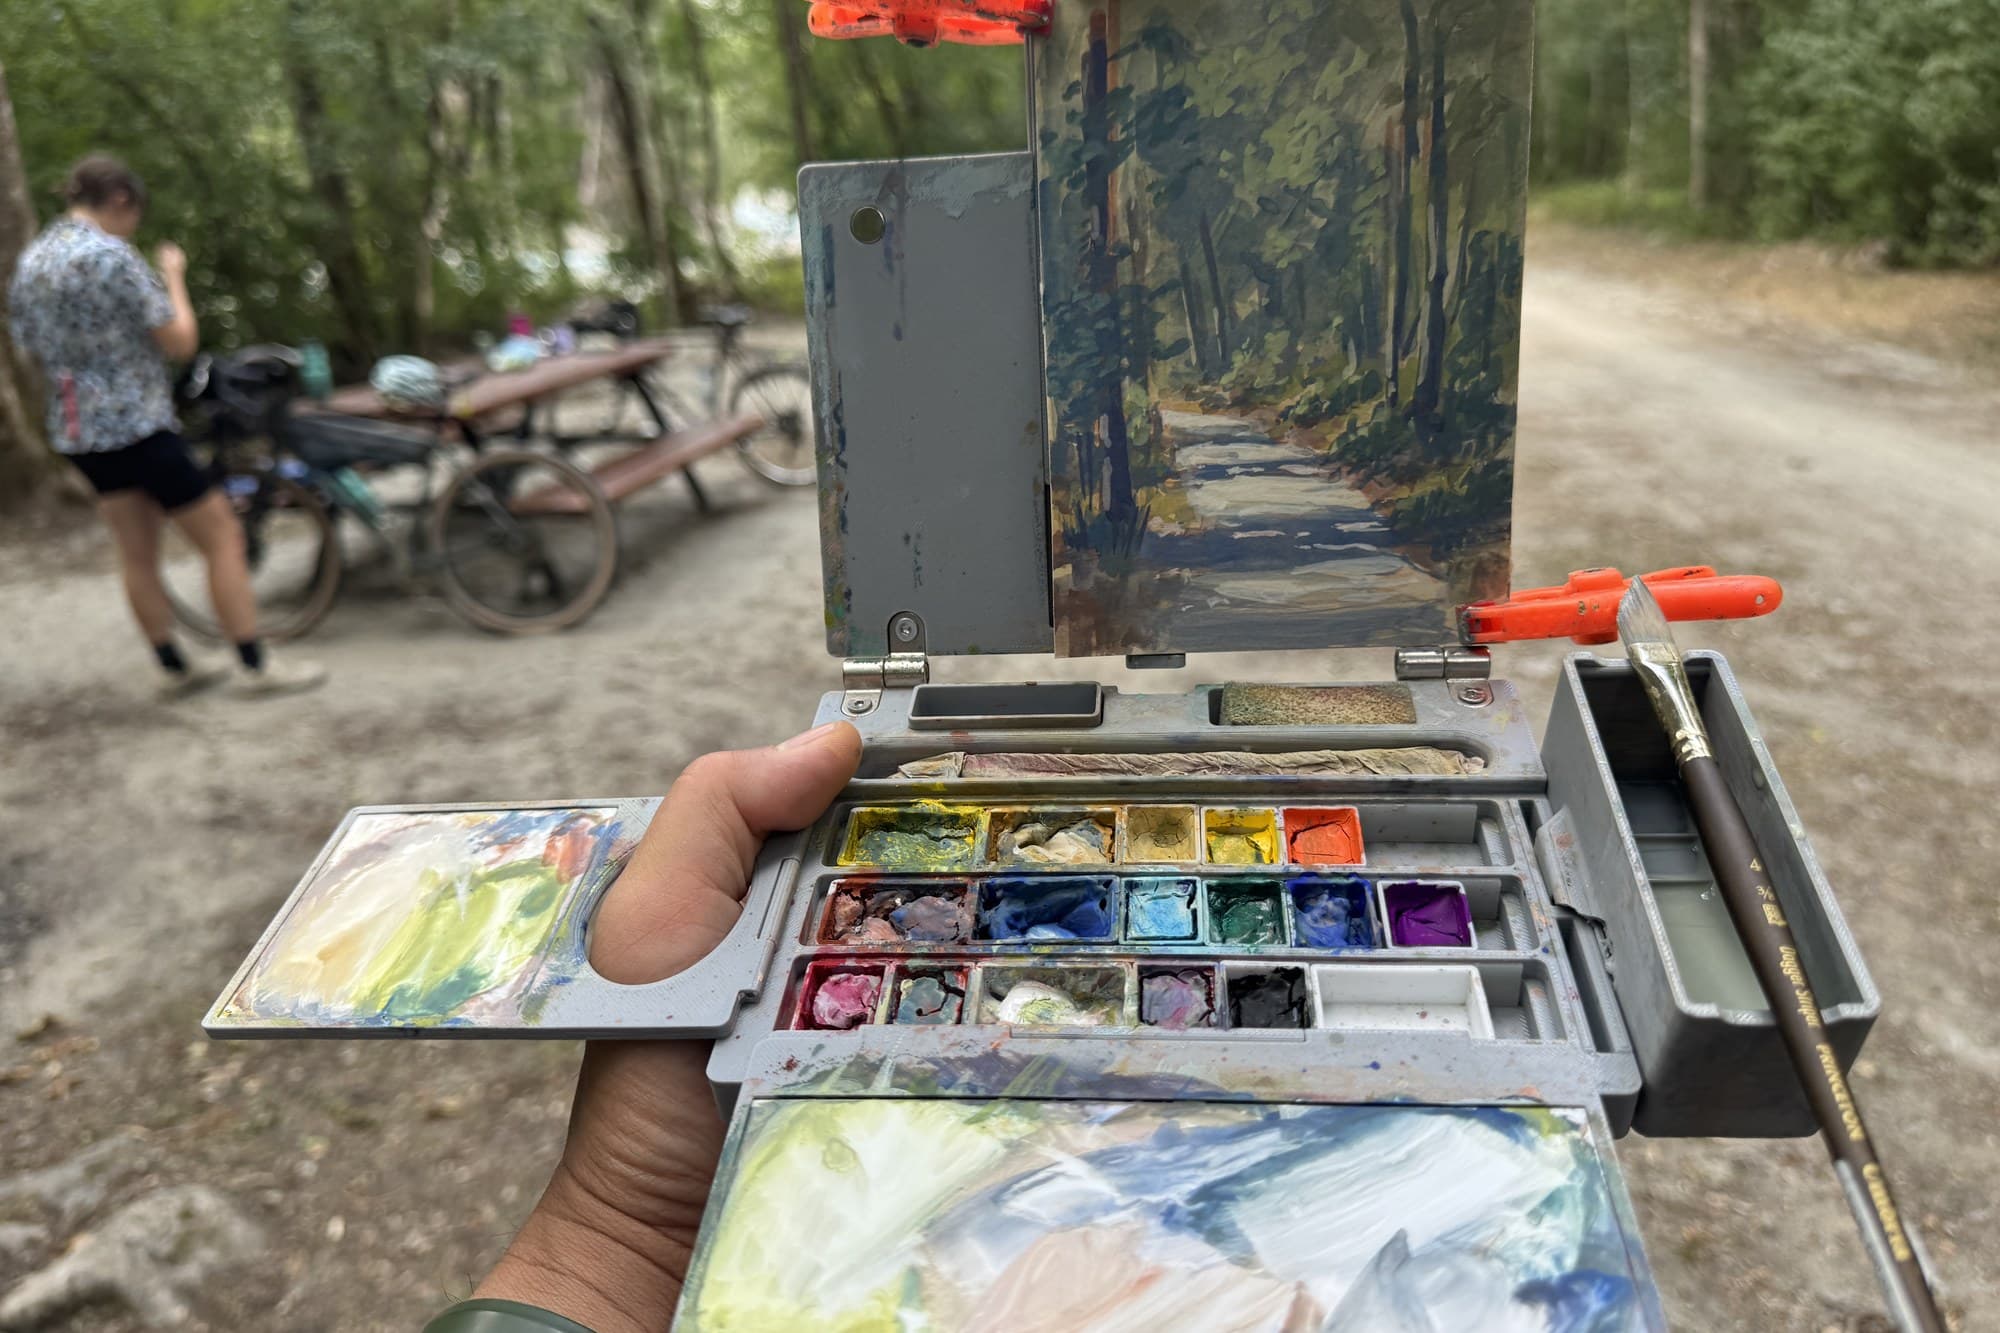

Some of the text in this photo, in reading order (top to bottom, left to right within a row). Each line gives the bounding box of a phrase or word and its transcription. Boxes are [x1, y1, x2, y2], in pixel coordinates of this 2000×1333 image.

[1750, 858, 1762, 872] 4
[1779, 945, 1803, 988] Dagger
[1816, 1043, 1865, 1142] PRINCETON
